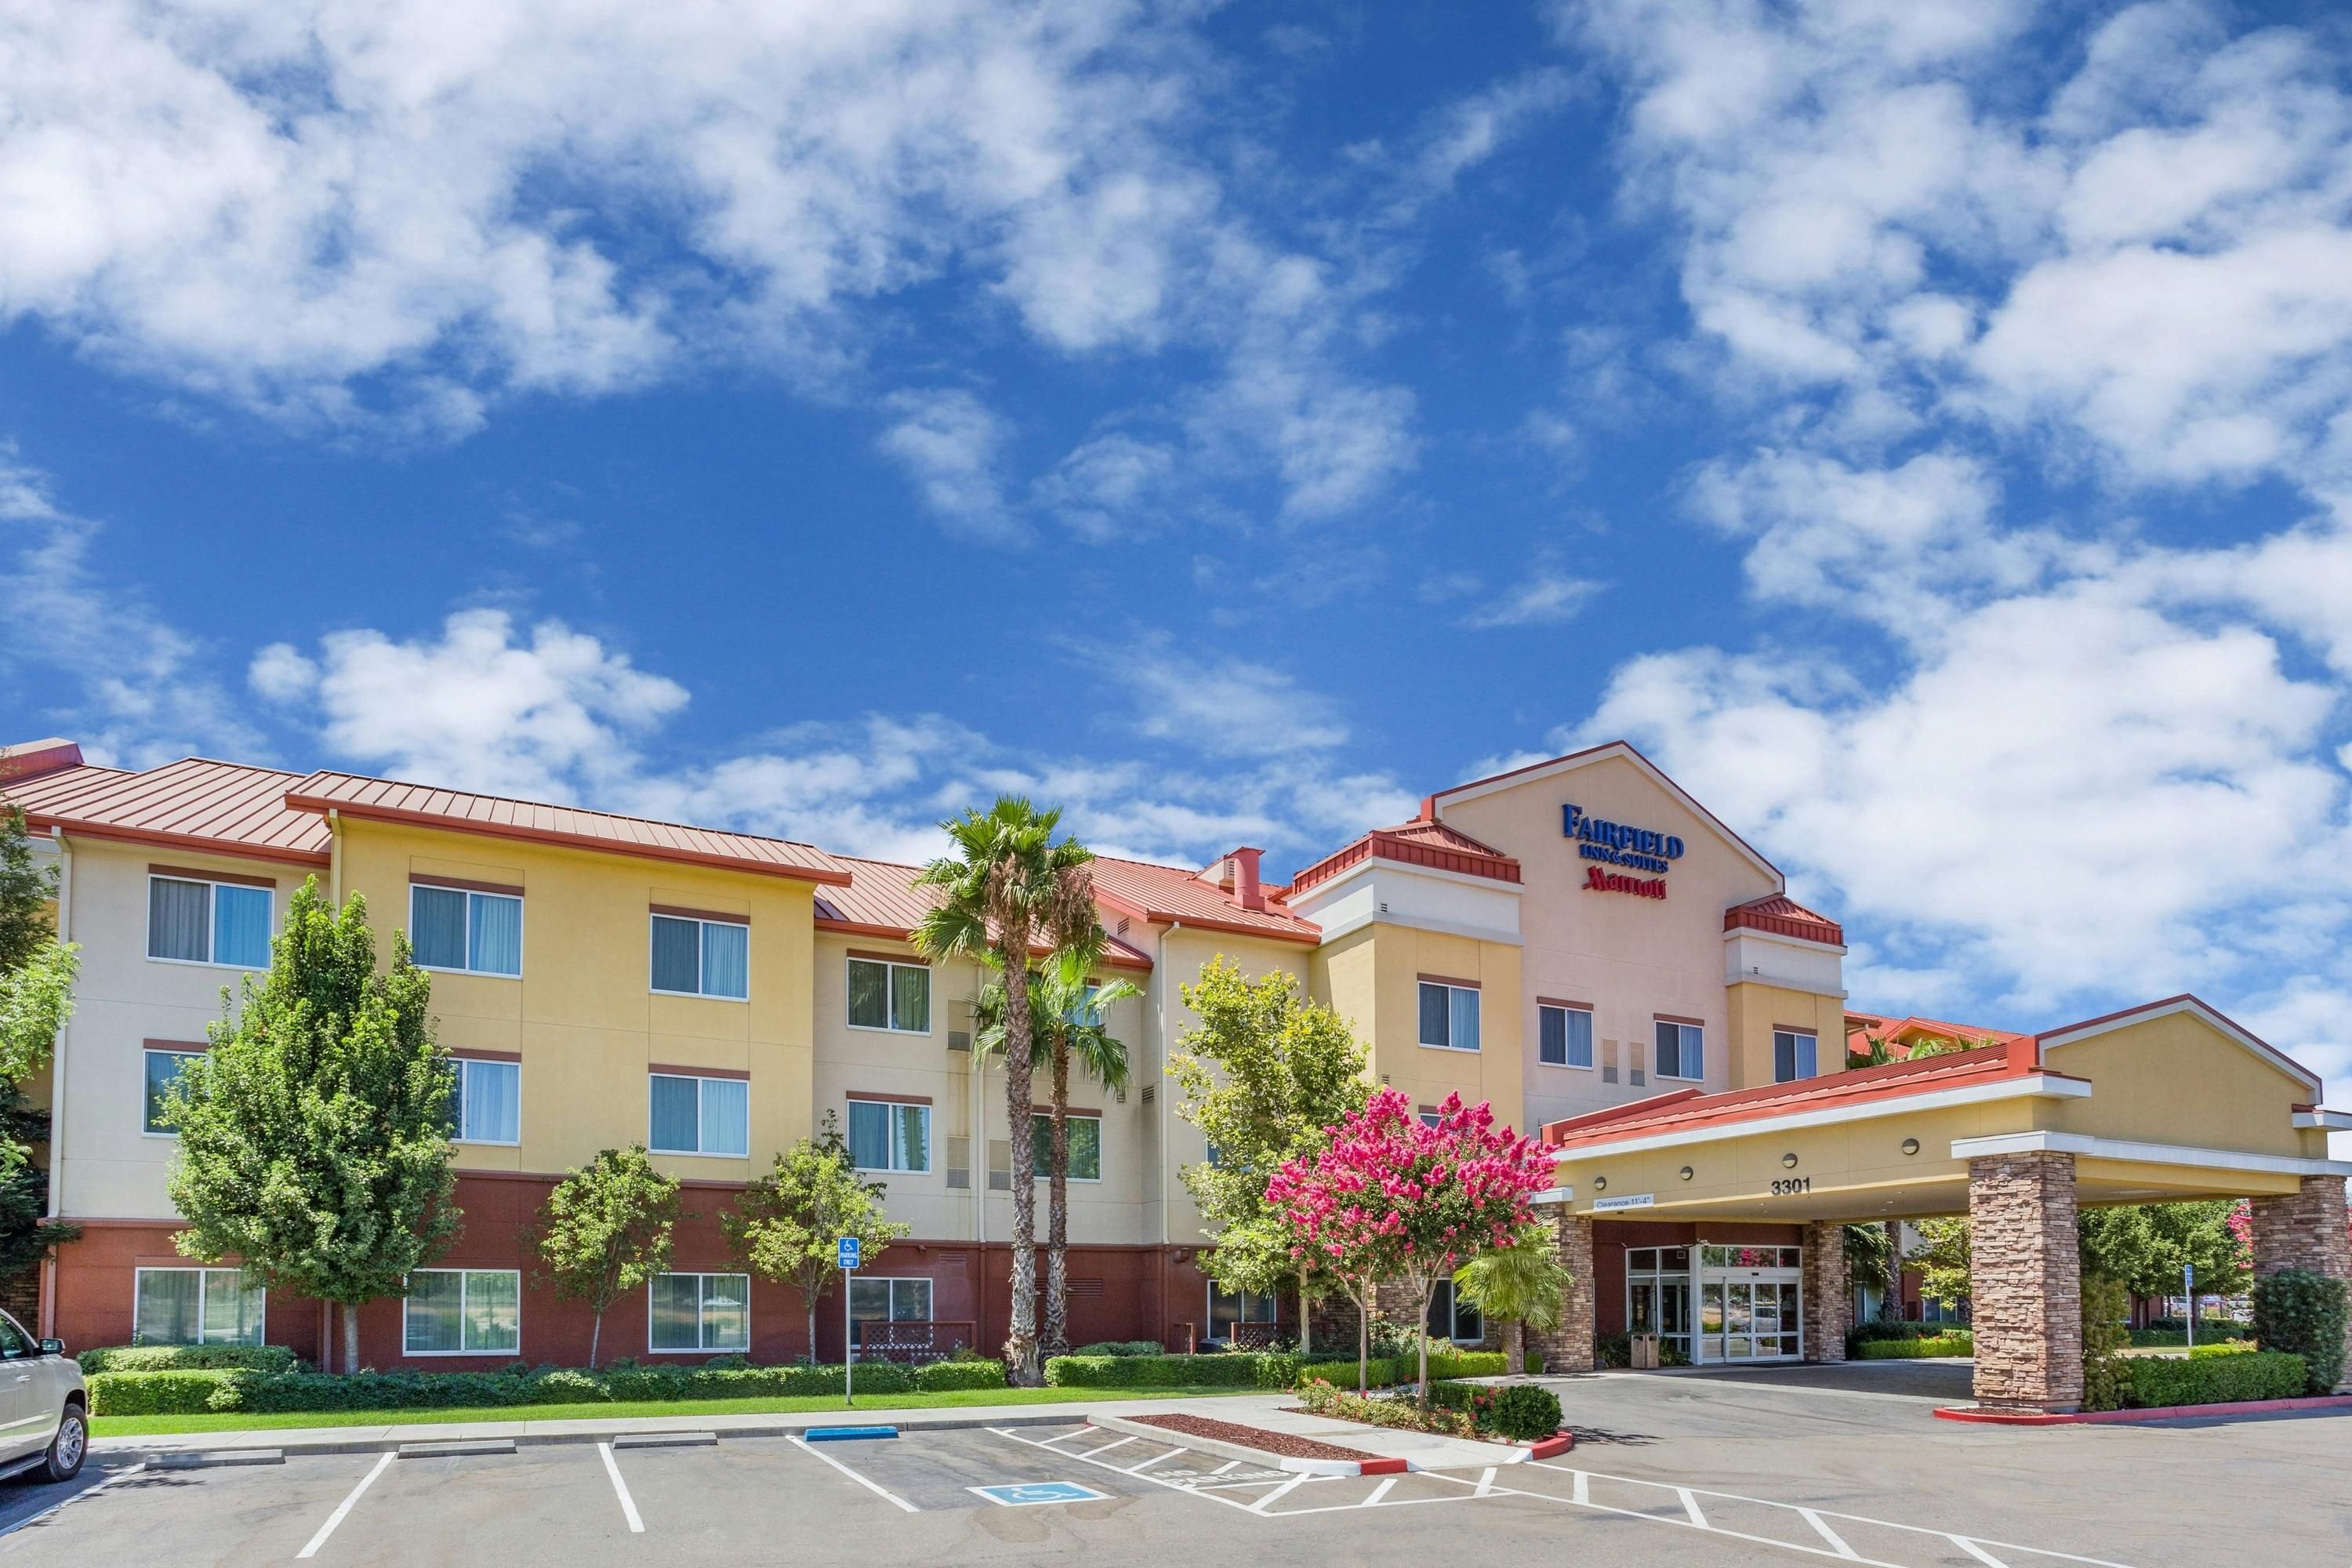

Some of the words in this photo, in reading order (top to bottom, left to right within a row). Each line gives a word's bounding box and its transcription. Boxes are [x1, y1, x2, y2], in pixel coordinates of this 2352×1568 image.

[1562, 804, 1684, 859] FAIRFIELD
[1579, 843, 1611, 862] INN
[1610, 850, 1623, 866] &
[1621, 852, 1669, 874] SUITES
[1582, 866, 1668, 900] Marriott
[1771, 1177, 1810, 1196] 3301
[1596, 1200, 1629, 1209] Clearance
[1163, 1470, 1290, 1486] PARKING
